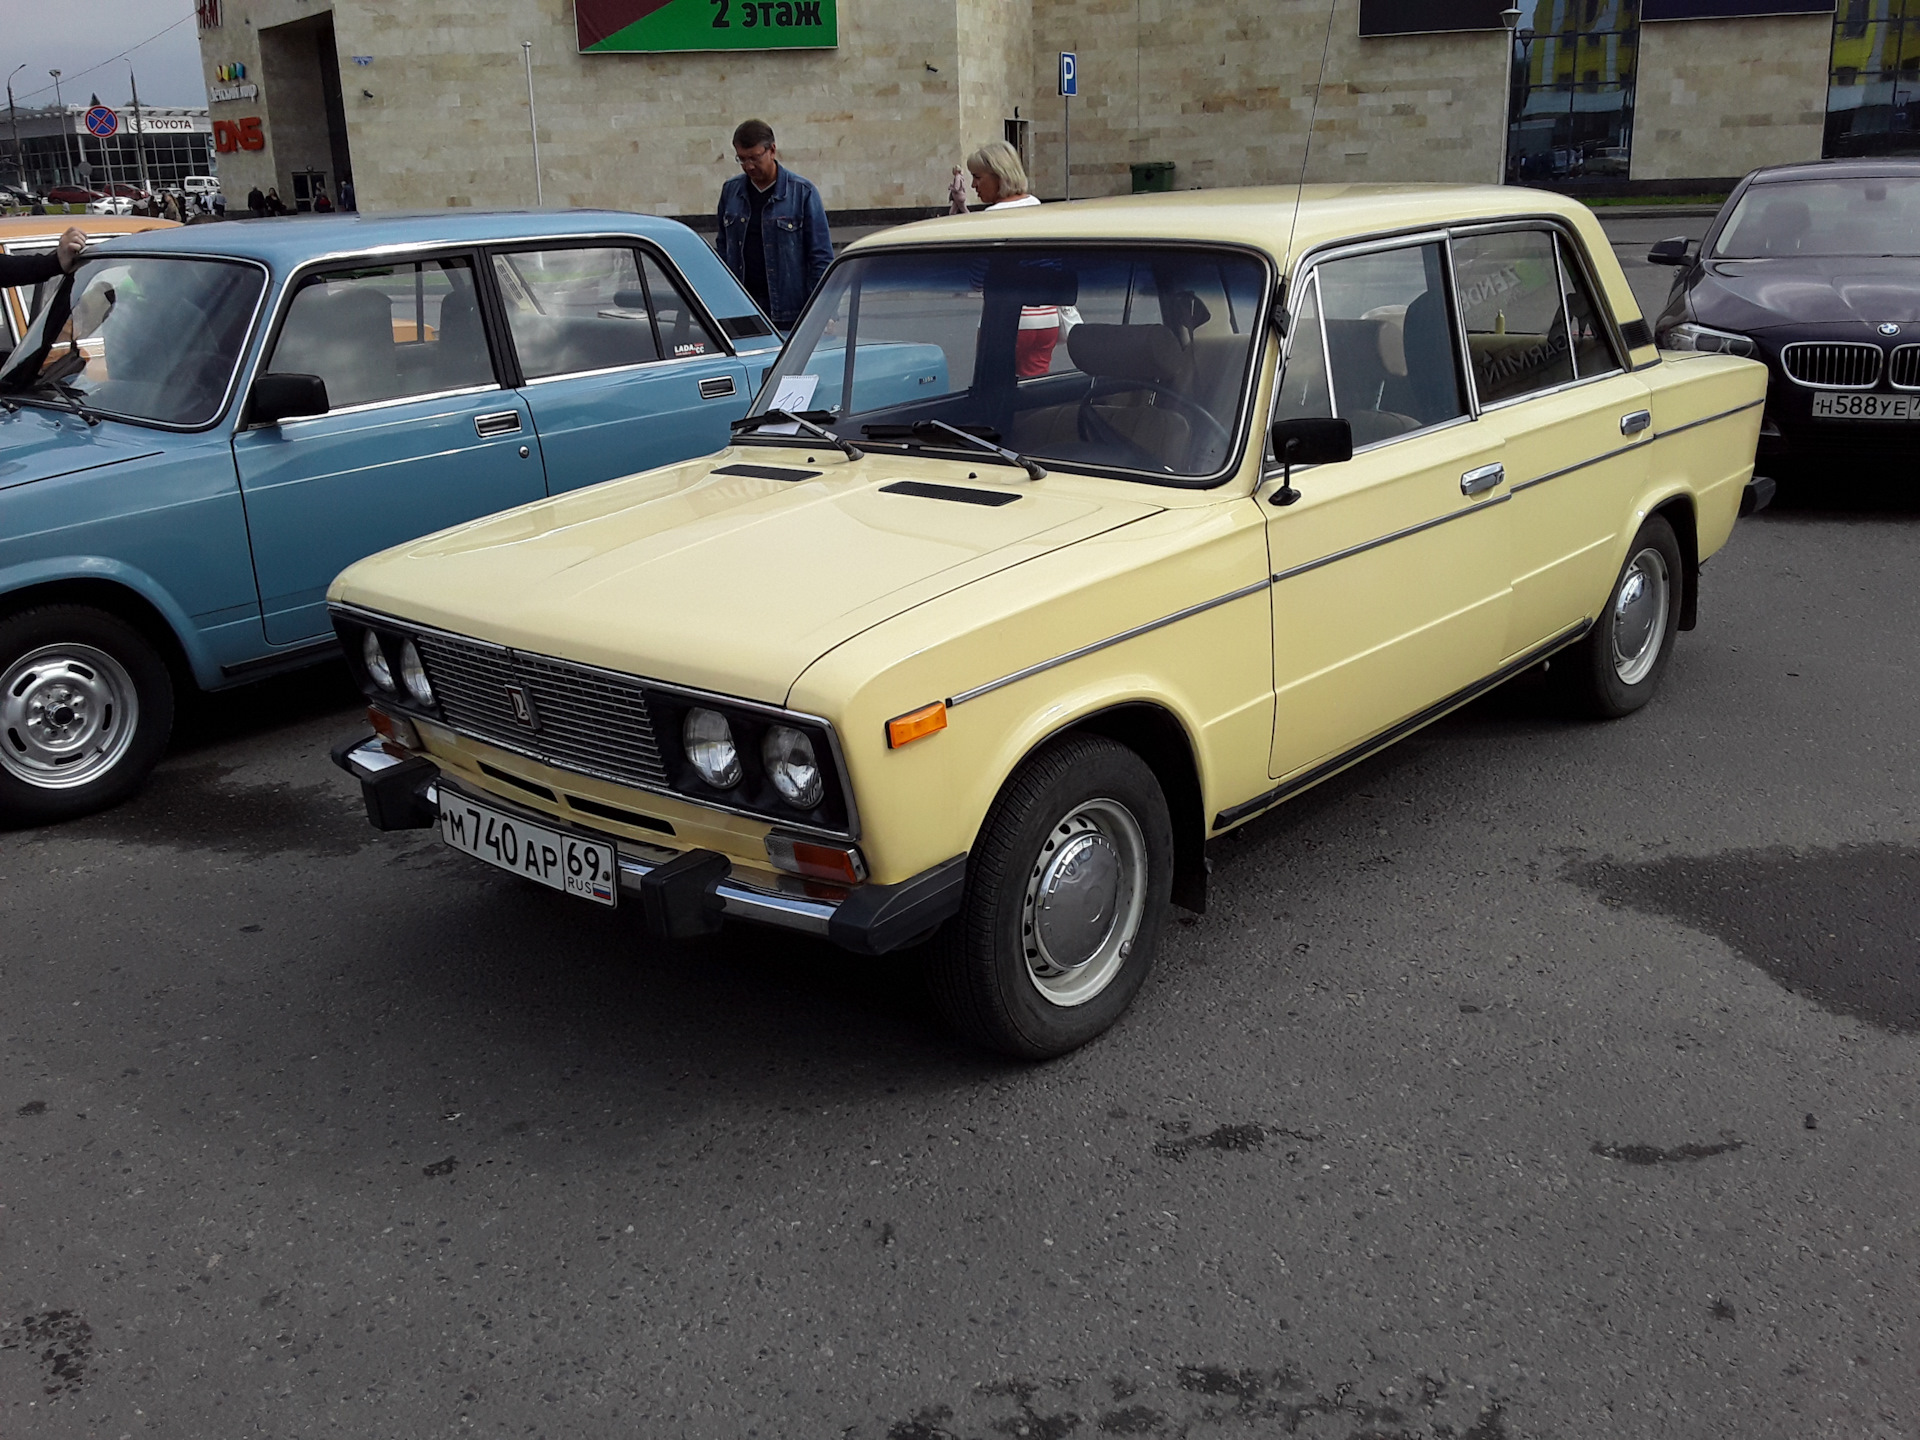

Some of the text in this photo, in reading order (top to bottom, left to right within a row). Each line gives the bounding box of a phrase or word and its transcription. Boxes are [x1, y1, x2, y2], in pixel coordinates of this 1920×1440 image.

[710, 0, 822, 28] 2 этаж
[1063, 56, 1074, 92] P
[148, 119, 192, 130] TOYOTA
[213, 117, 265, 153] DNS
[567, 842, 600, 881] 69
[567, 877, 592, 894] RUS
